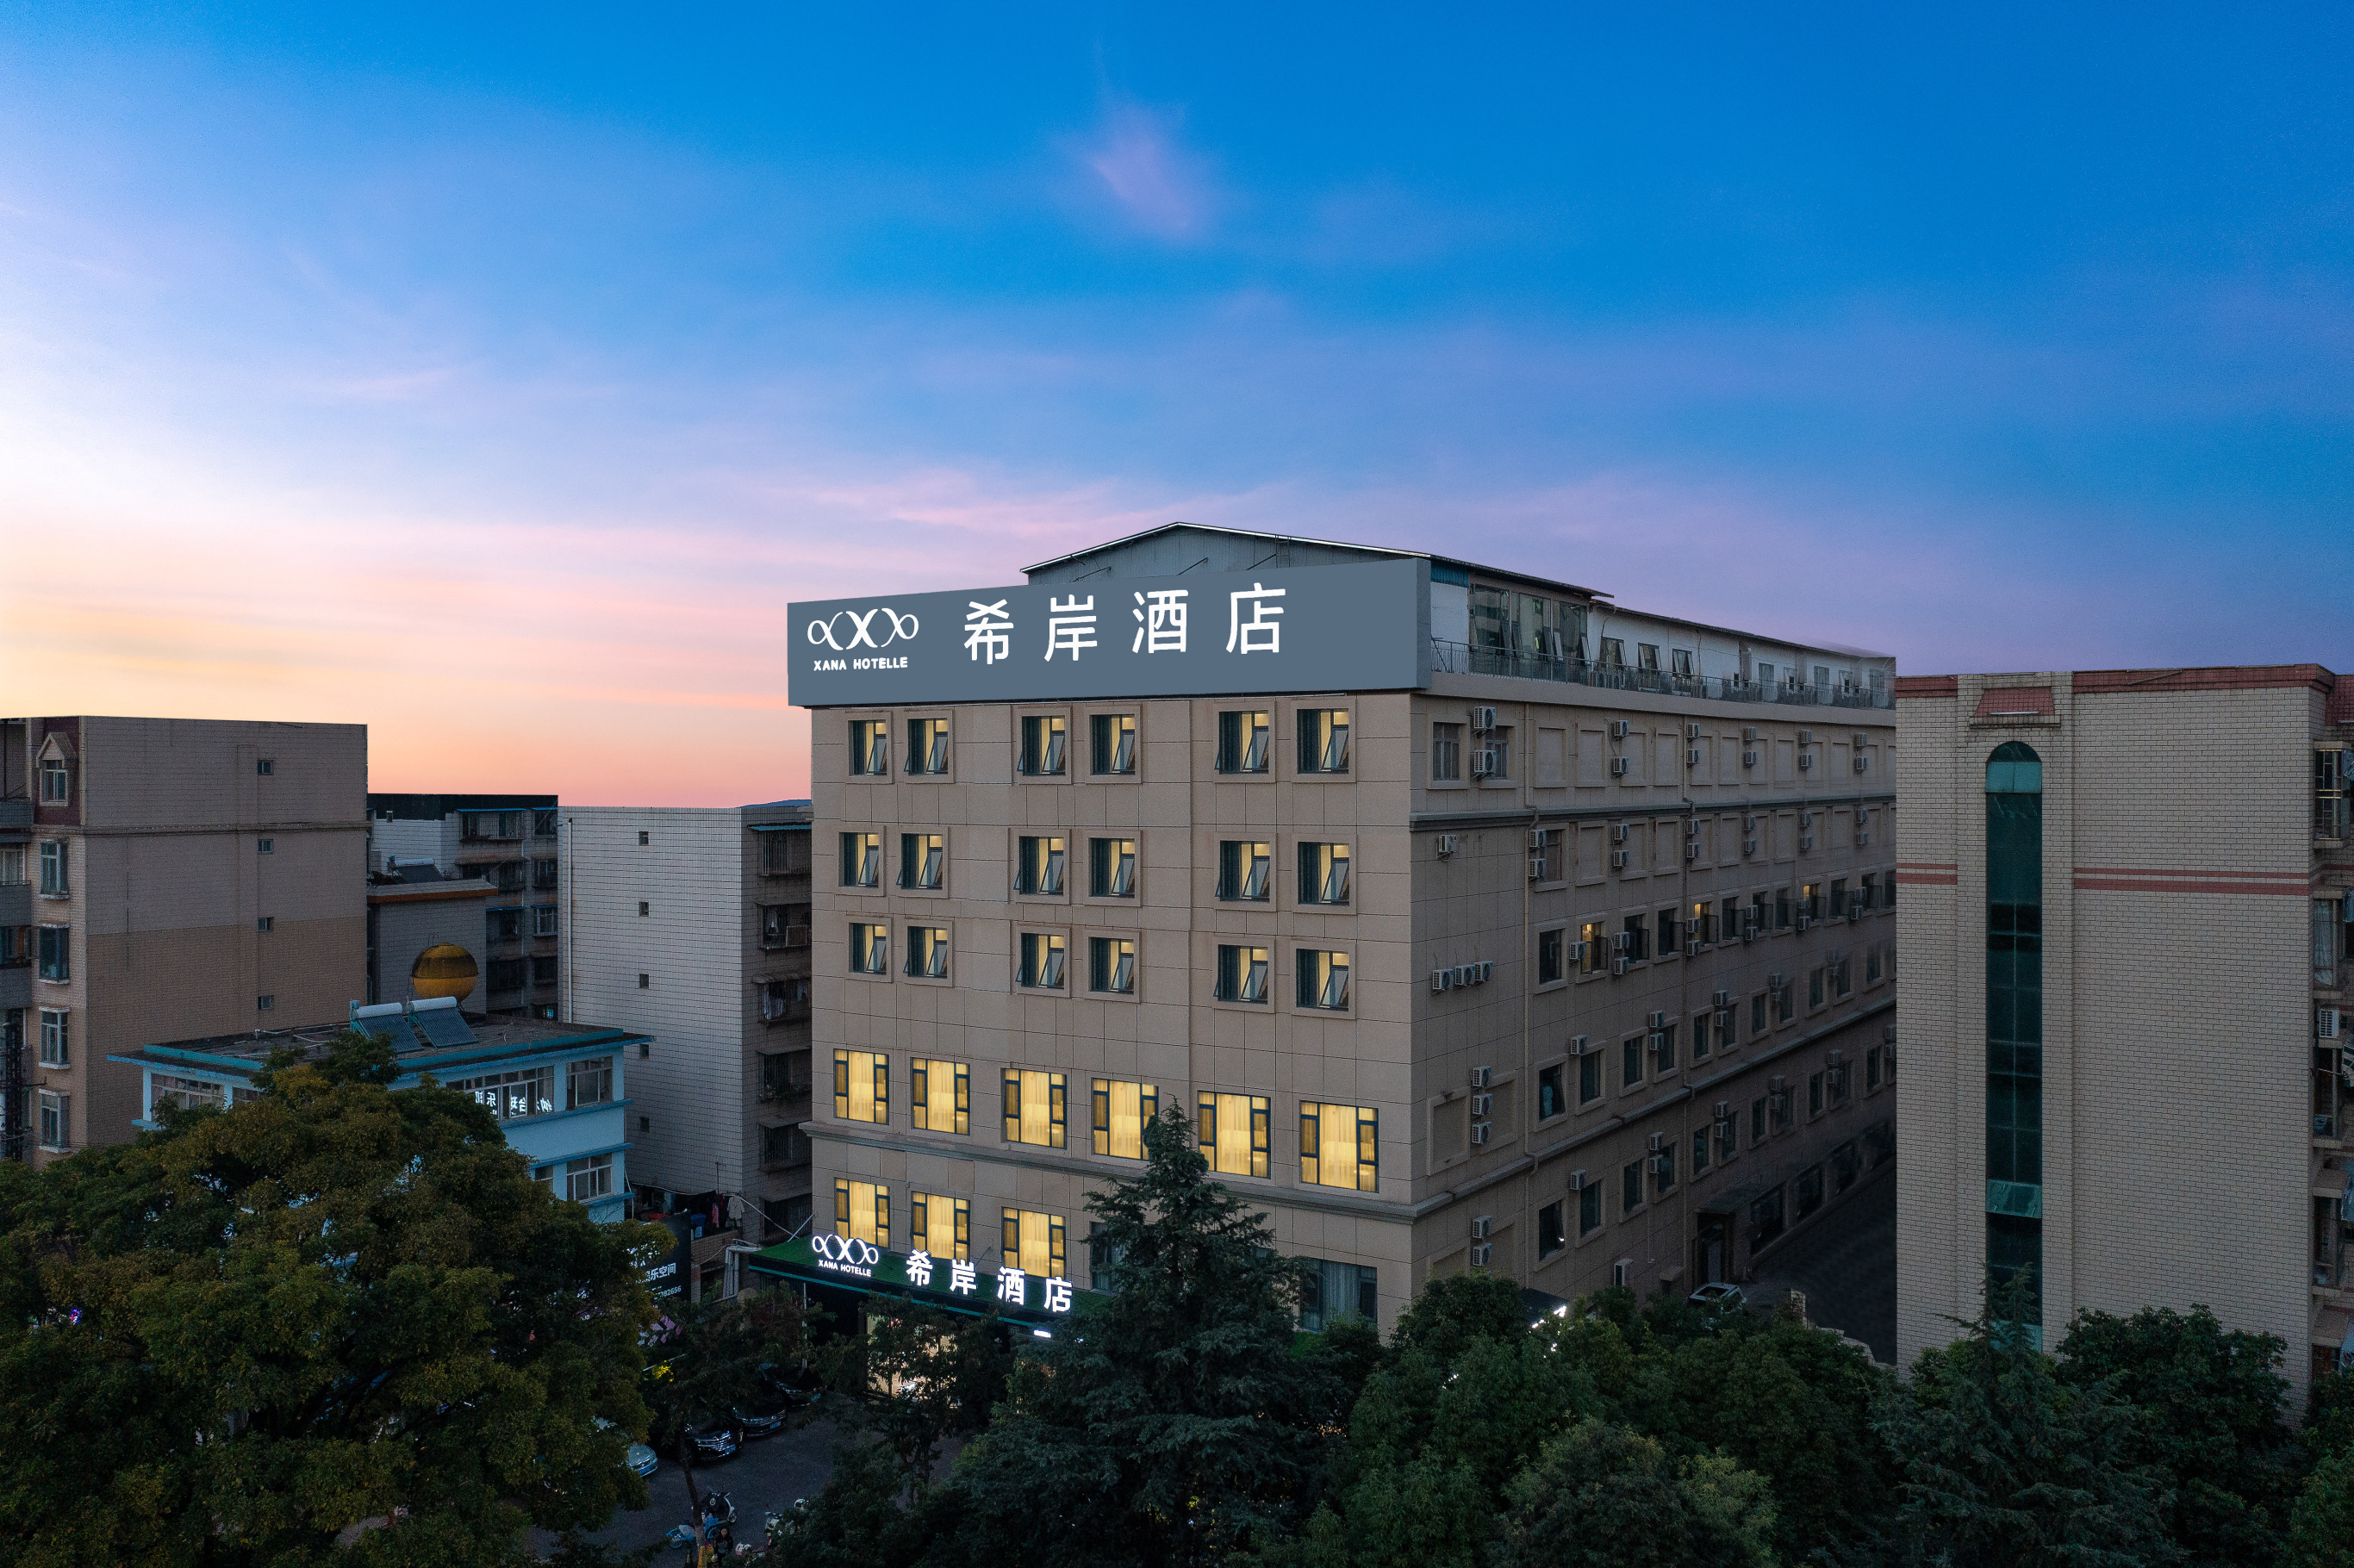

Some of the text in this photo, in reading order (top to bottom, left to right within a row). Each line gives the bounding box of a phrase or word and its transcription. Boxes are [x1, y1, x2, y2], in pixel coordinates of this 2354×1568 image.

[964, 582, 1287, 665] 希岸酒店
[813, 656, 908, 671] XANA HOTELLE
[818, 1259, 872, 1278] XANA HOTELLE
[906, 1248, 1073, 1313] 希岸酒店
